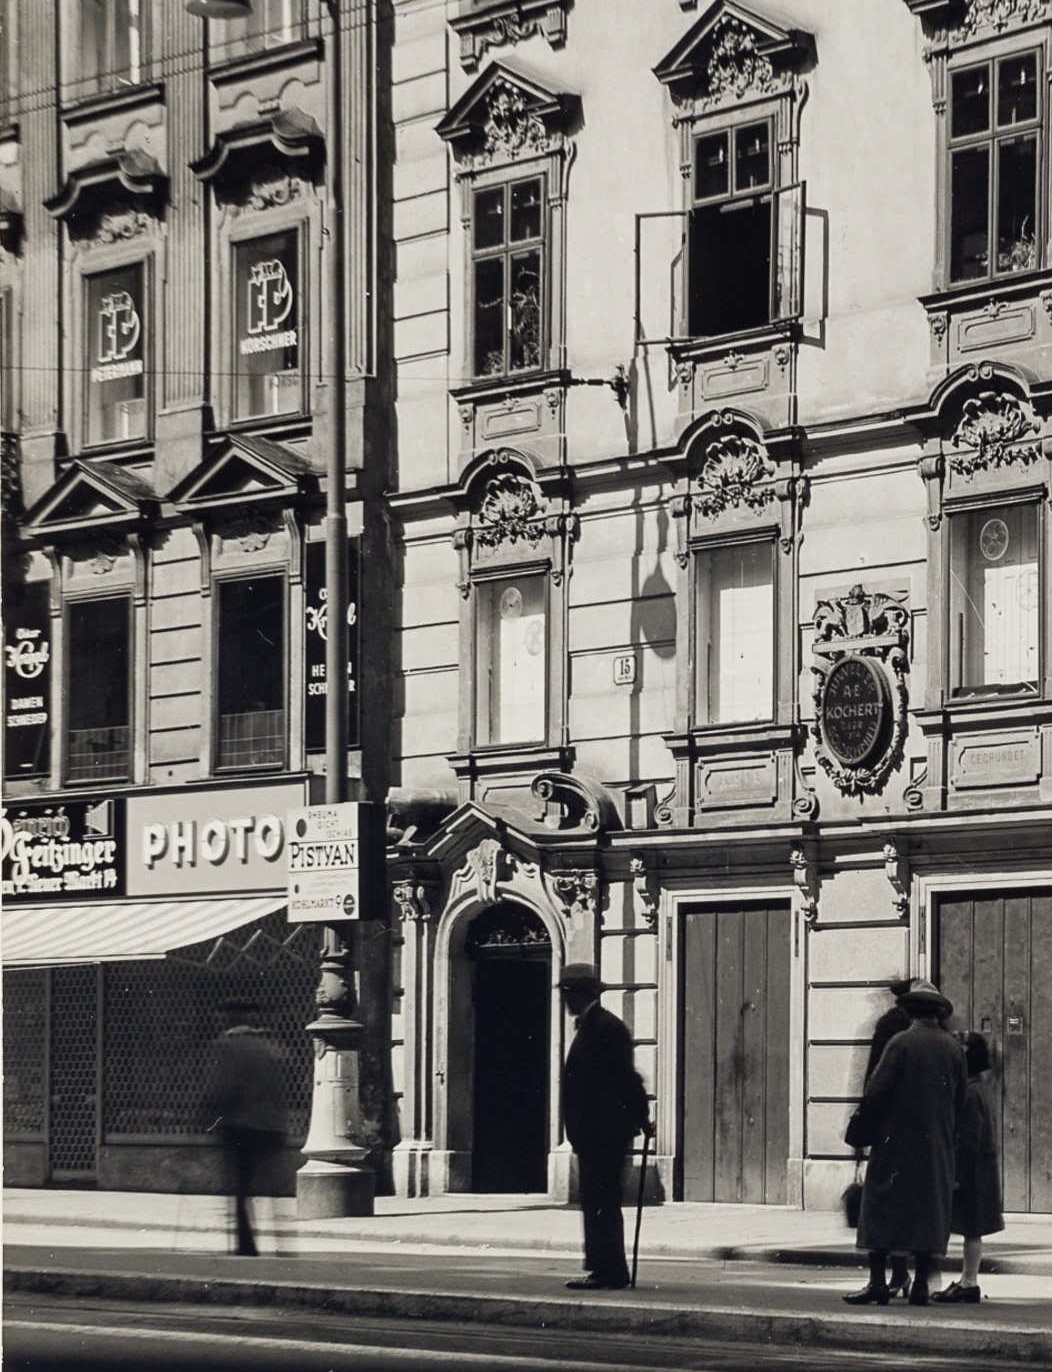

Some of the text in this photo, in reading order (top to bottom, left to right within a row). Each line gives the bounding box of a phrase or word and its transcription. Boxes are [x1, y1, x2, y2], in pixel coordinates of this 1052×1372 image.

[620, 658, 631, 675] 15
[142, 813, 284, 870] PHOTO
[289, 841, 355, 869] PISTYAN
